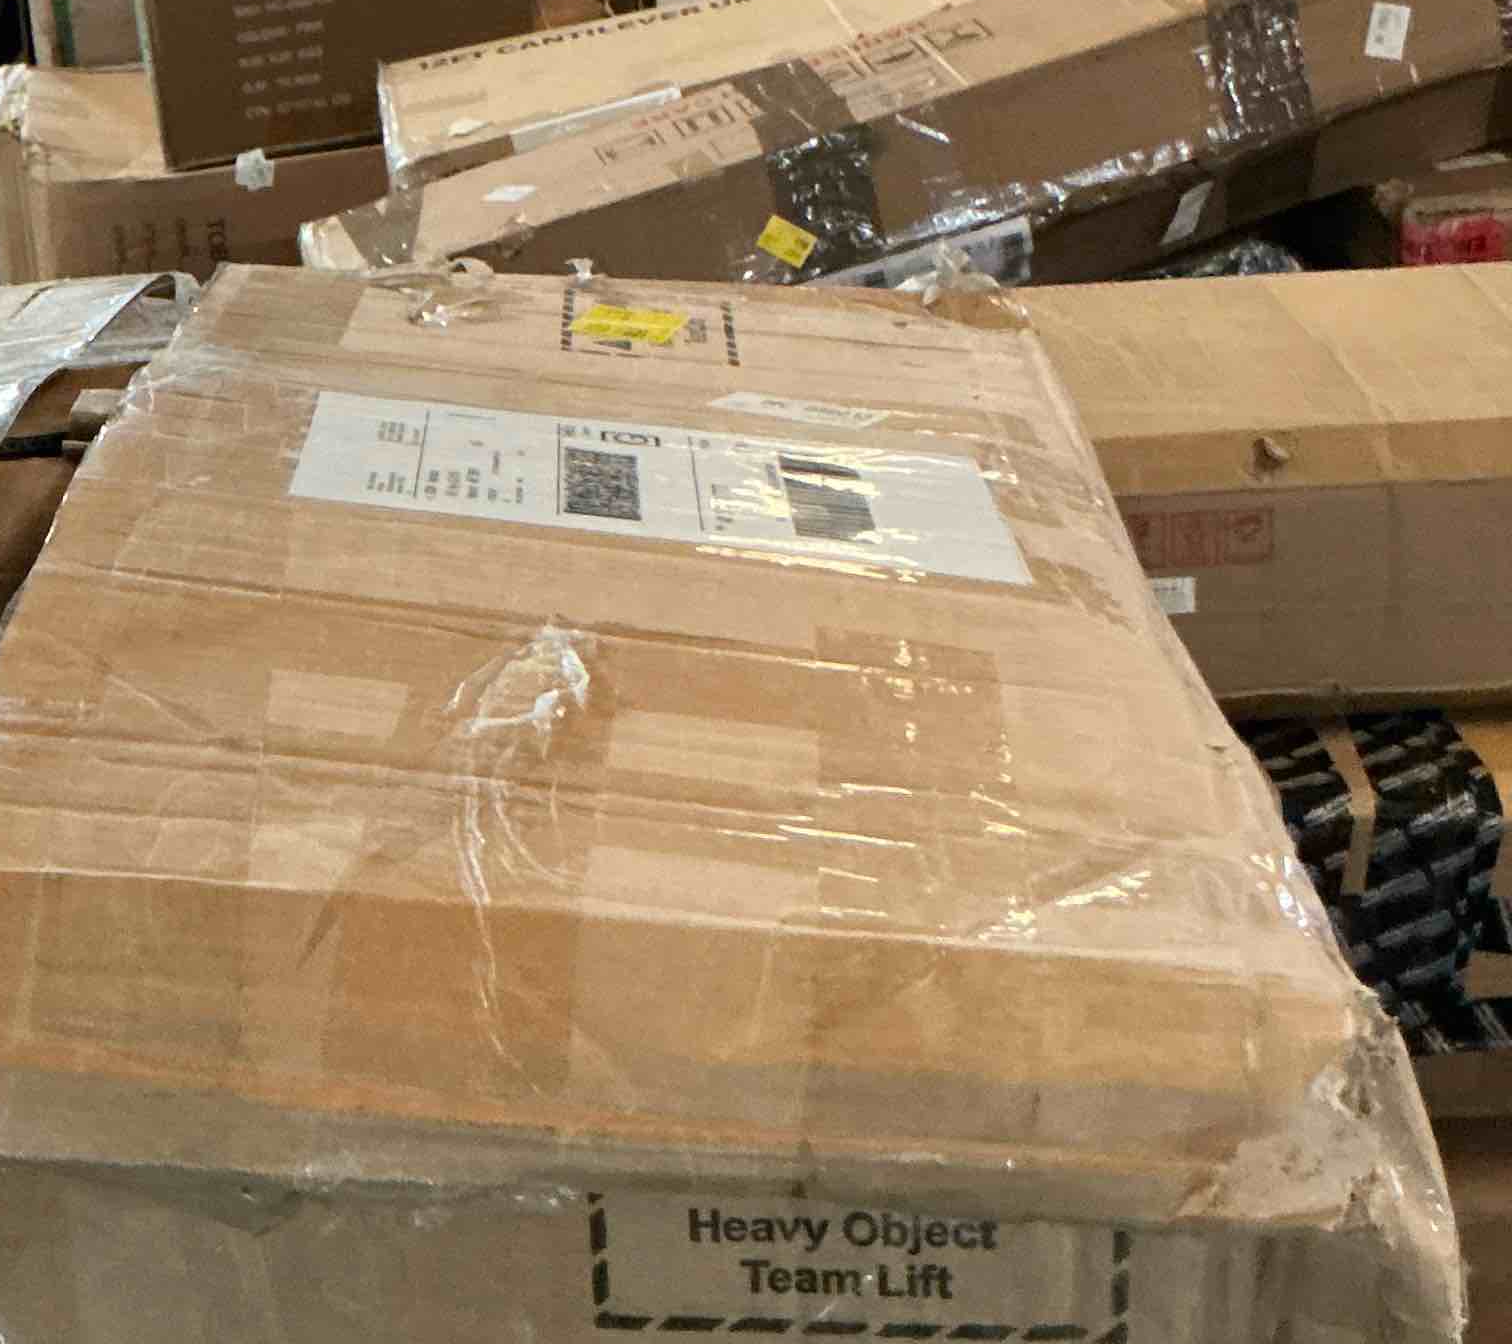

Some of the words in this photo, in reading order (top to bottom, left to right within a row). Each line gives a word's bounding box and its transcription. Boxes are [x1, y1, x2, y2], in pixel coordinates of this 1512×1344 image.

[496, 6, 700, 54] CANTILEVER
[687, 1208, 829, 1251] Heavy
[842, 1211, 999, 1255] Object
[740, 1259, 864, 1296] Team
[877, 1264, 954, 1300] Lift
